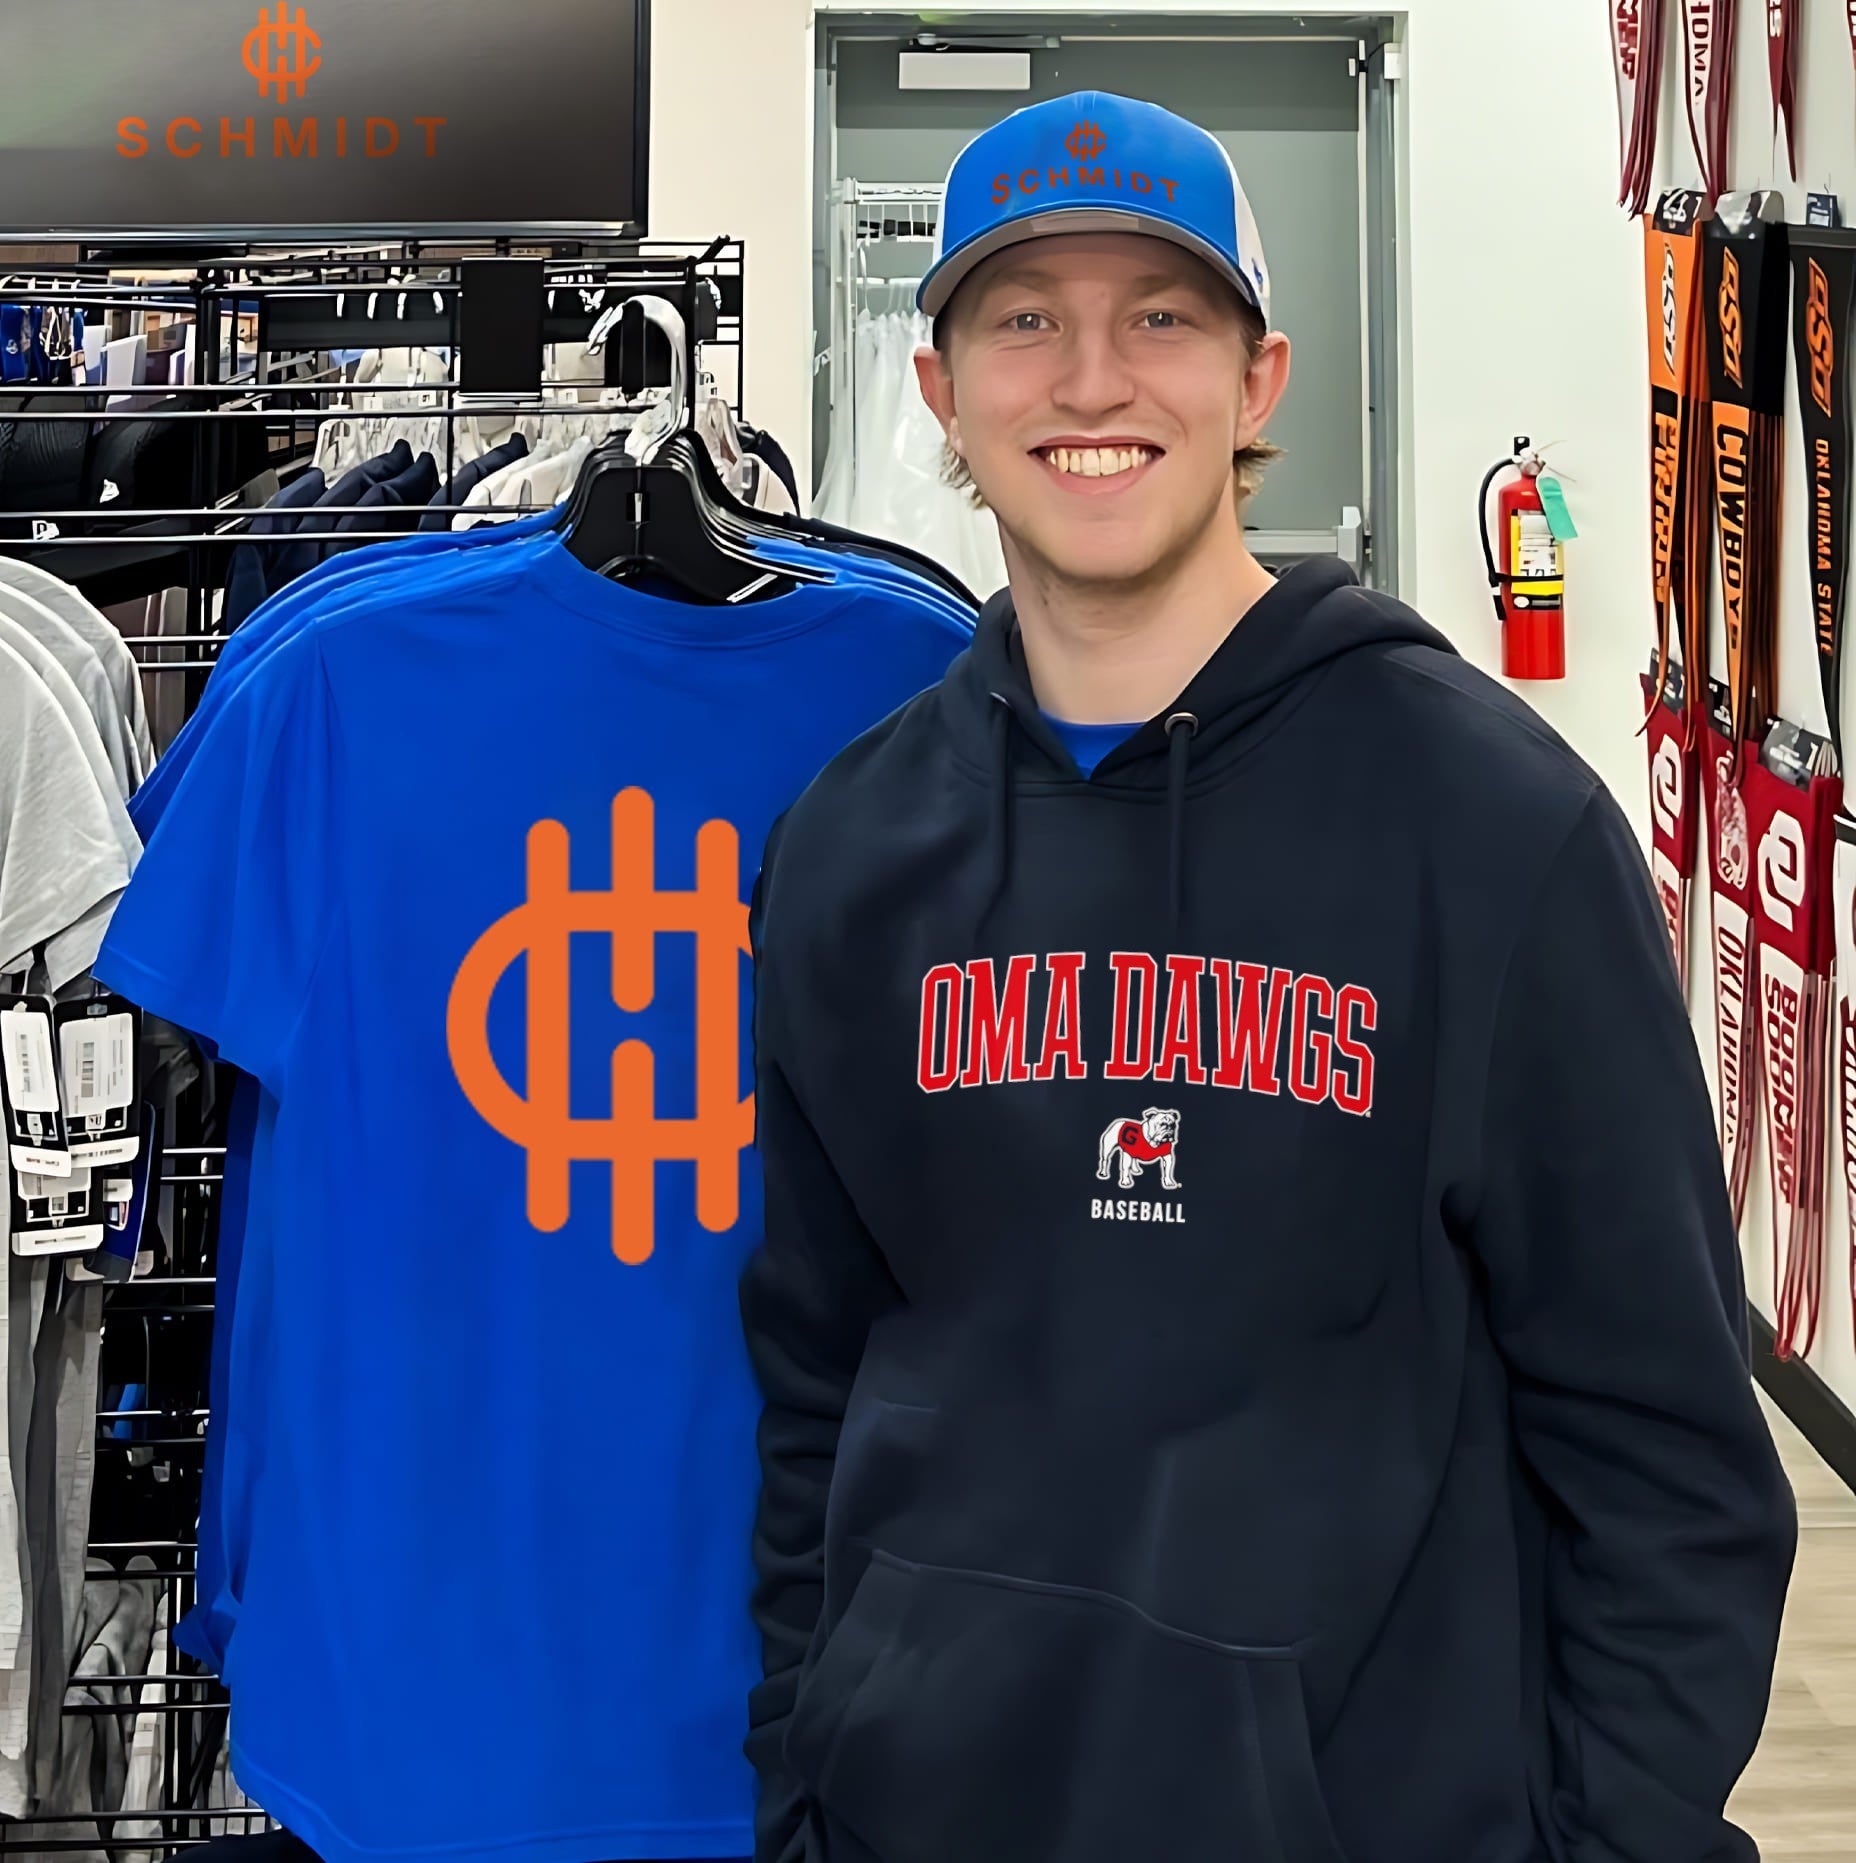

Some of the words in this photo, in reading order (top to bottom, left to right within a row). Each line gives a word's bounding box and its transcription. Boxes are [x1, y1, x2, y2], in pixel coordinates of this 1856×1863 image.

[116, 116, 448, 159] SCHMIDT
[991, 166, 1180, 205] SCHMIDT
[1814, 438, 1833, 570] OKLAHOMA
[916, 951, 1088, 1094] OMA
[1103, 950, 1379, 1117] DAWGS
[1717, 925, 1745, 1144] OKLAHOMA
[1090, 1198, 1187, 1224] BASEBALL
